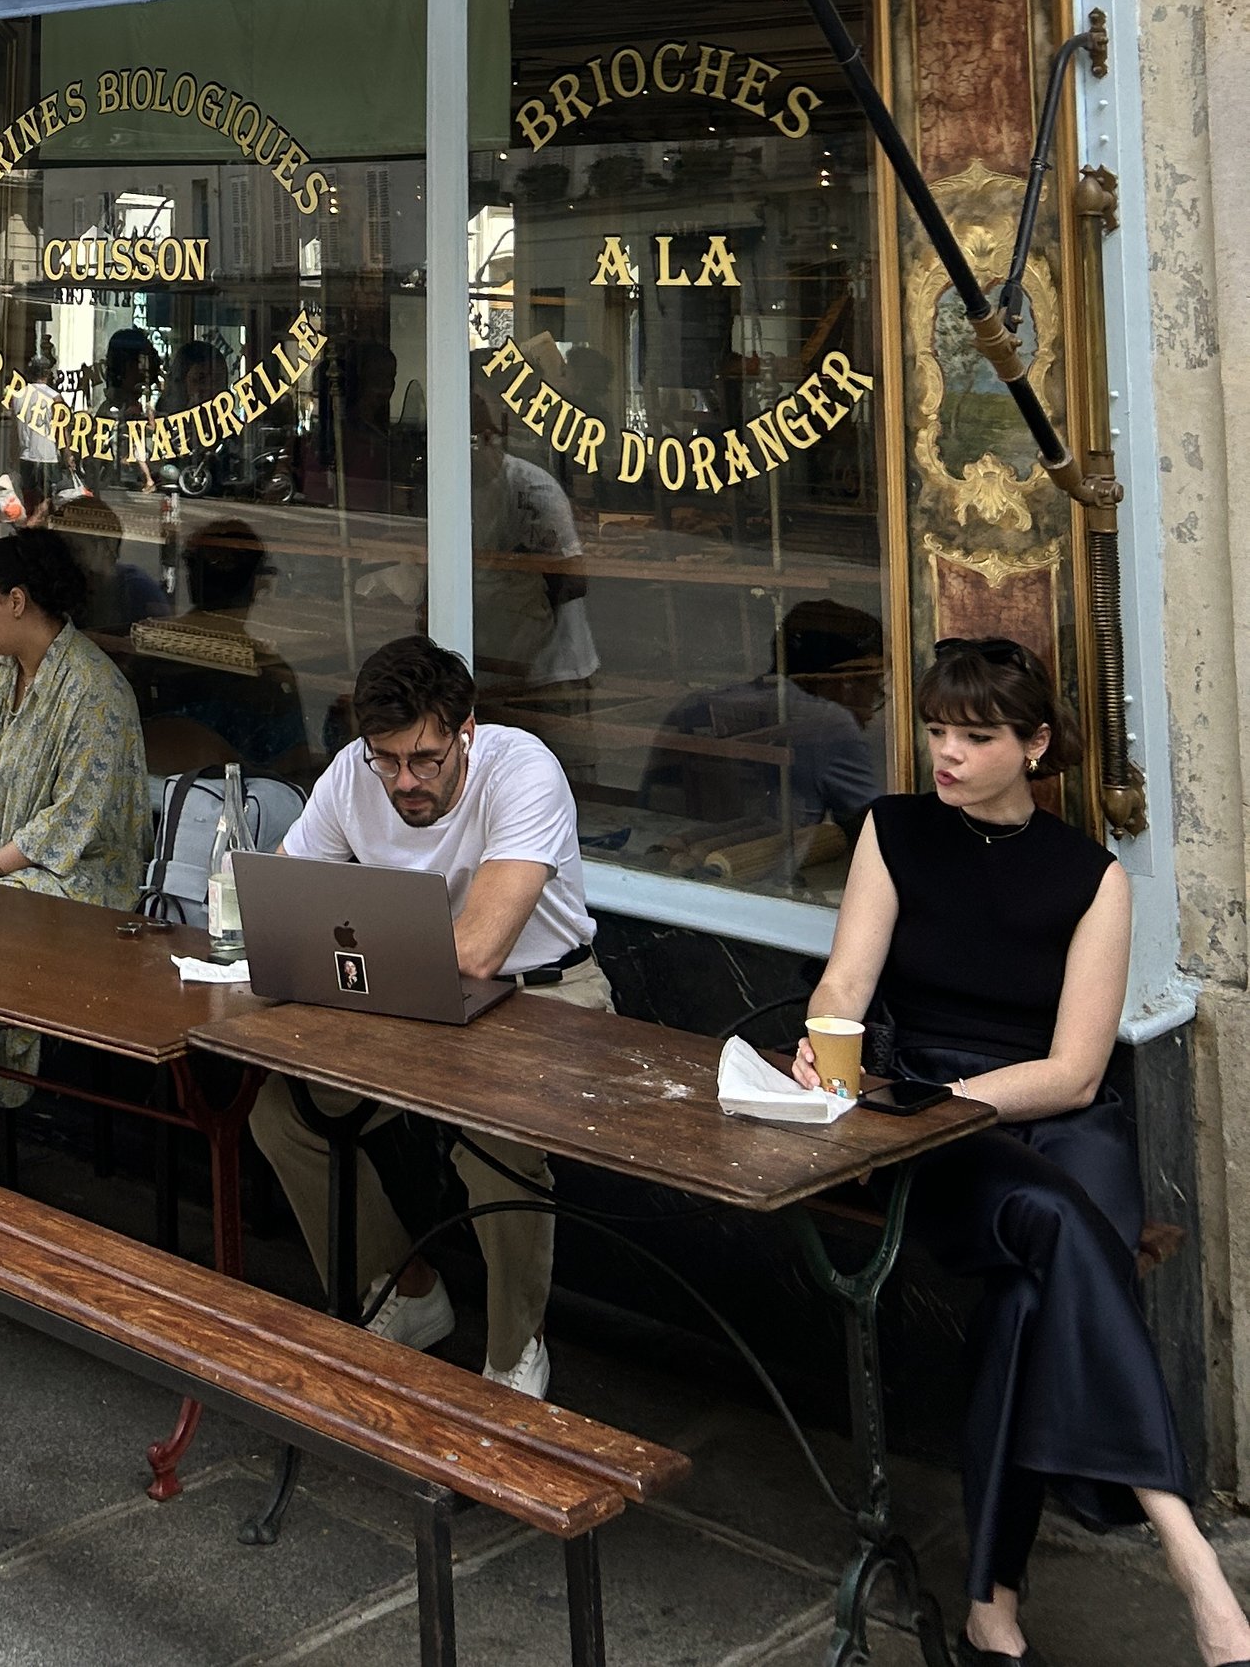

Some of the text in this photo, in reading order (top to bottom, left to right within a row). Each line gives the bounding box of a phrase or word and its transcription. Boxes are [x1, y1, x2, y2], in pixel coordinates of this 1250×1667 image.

[97, 65, 330, 215] BIOLOGIQUES
[514, 40, 824, 153] BRIOCHES
[43, 237, 210, 282] CUISSON
[590, 236, 742, 287] A LA
[0, 374, 117, 461] PIERRE
[126, 310, 329, 463] NATURELLE
[481, 335, 876, 495] FLEUR D'ORANGER
